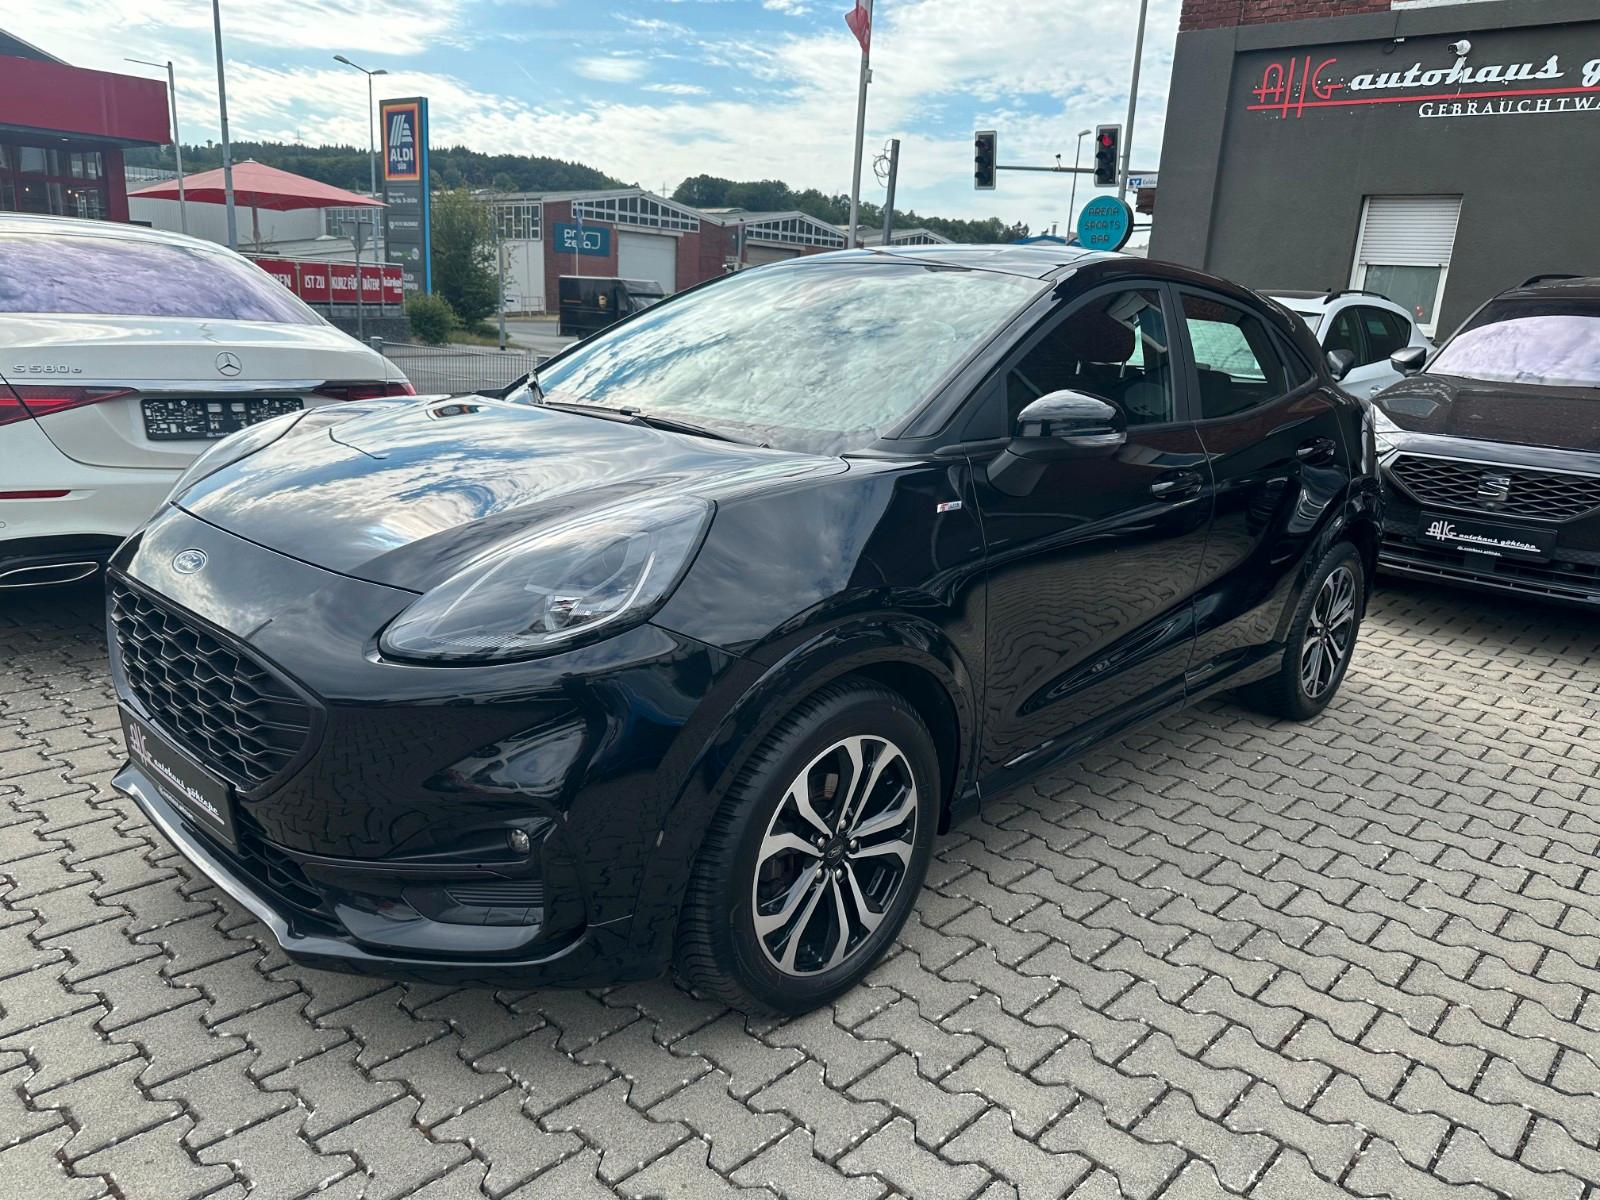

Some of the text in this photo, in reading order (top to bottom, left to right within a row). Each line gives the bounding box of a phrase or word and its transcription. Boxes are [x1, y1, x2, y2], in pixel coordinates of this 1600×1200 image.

[1252, 55, 1344, 119] AHG
[1350, 54, 1565, 91] autohaus
[1418, 96, 1600, 117] GEBRAUCHTW
[390, 147, 414, 162] ALDI
[1088, 207, 1119, 217] ARENA
[1084, 220, 1121, 231] SPORTS
[1091, 233, 1110, 244] BAR
[304, 275, 315, 289] IST
[315, 275, 325, 289] ZU
[331, 276, 347, 290] KURZ
